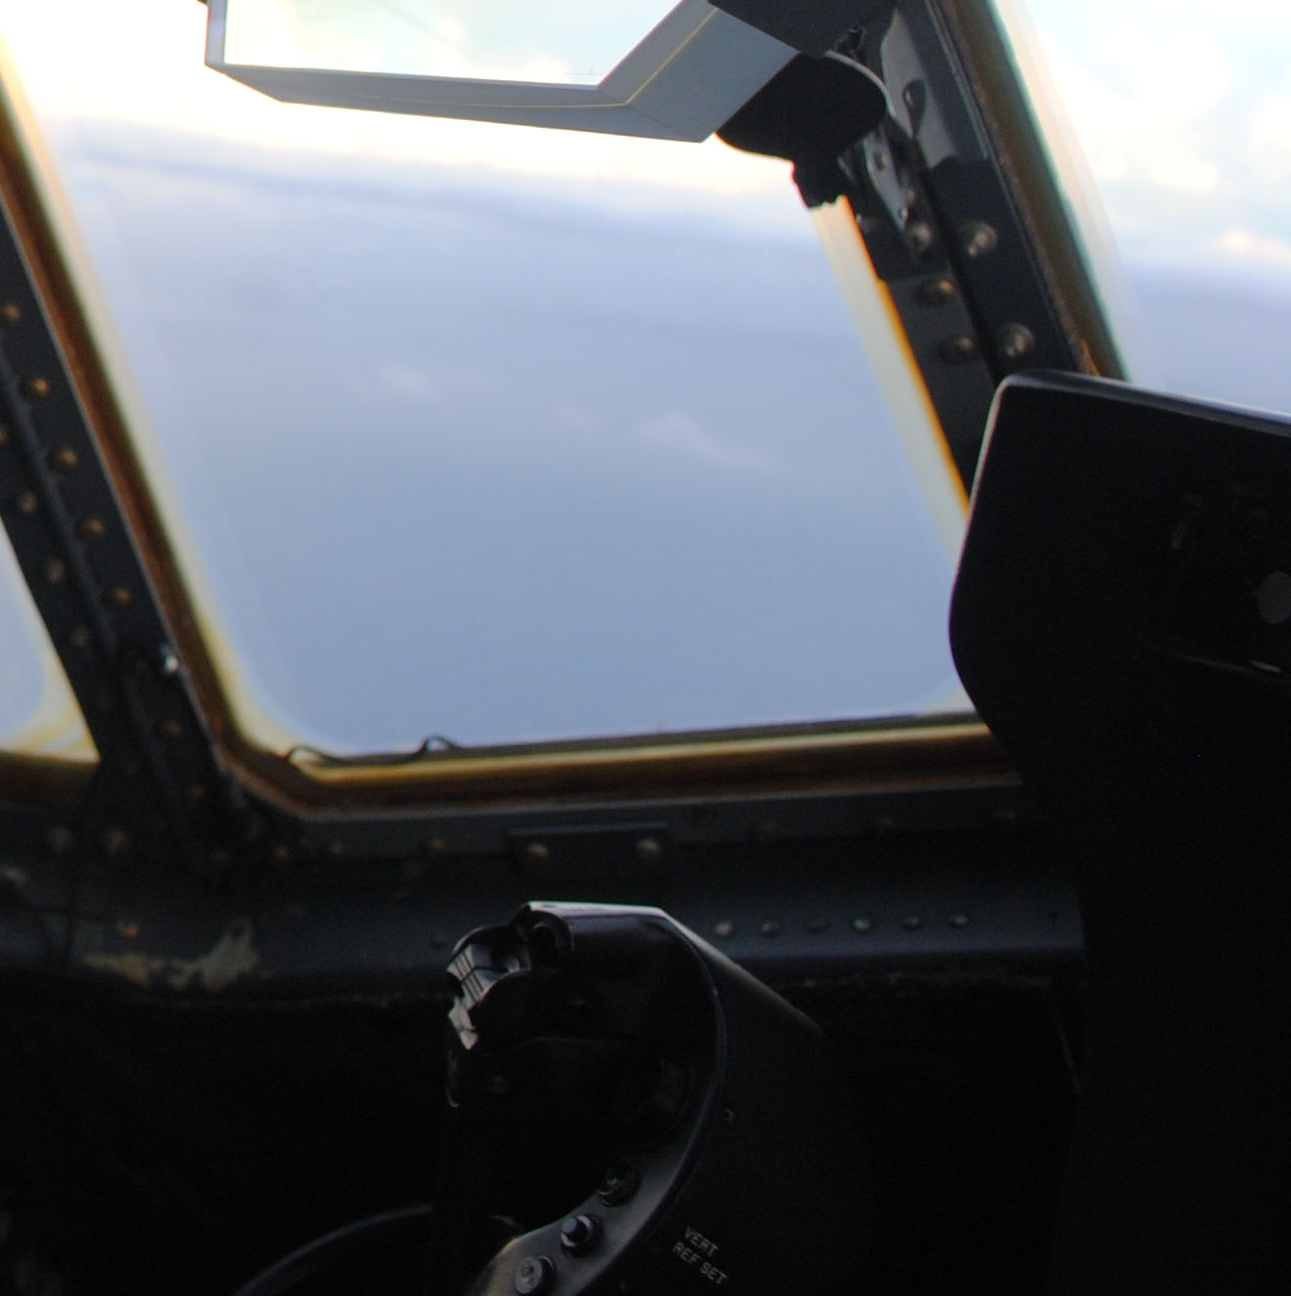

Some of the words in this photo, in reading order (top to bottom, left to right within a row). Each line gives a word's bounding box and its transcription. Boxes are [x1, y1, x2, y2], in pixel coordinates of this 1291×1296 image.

[684, 1225, 720, 1256] VERT
[672, 1241, 703, 1264] REF
[700, 1261, 728, 1284] SET
